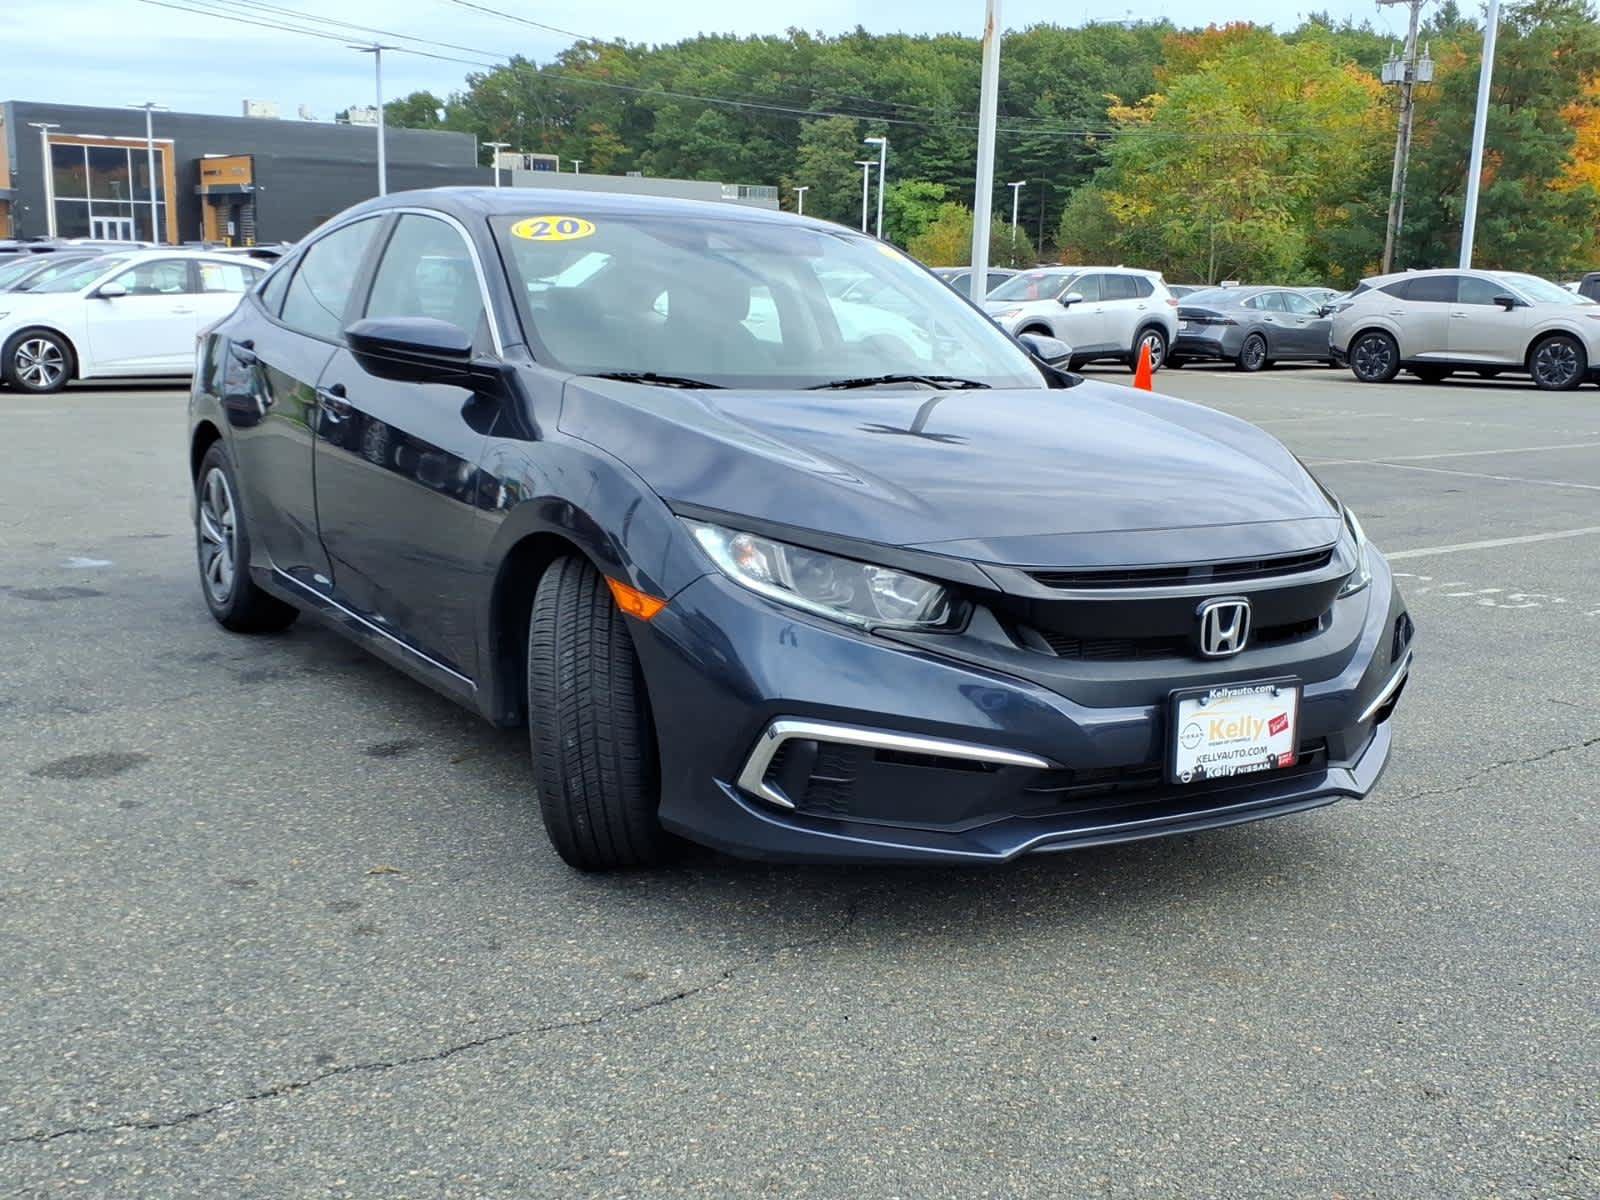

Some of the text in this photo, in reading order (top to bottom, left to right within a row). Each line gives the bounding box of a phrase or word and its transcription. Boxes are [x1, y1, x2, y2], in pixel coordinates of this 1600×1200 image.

[530, 220, 579, 236] 20
[1209, 685, 1275, 699] Kellyauto.com
[1208, 716, 1264, 741] Kelly
[1195, 746, 1268, 764] KELLYAUTO.COM
[1206, 763, 1271, 778] Kelly NISSAN
